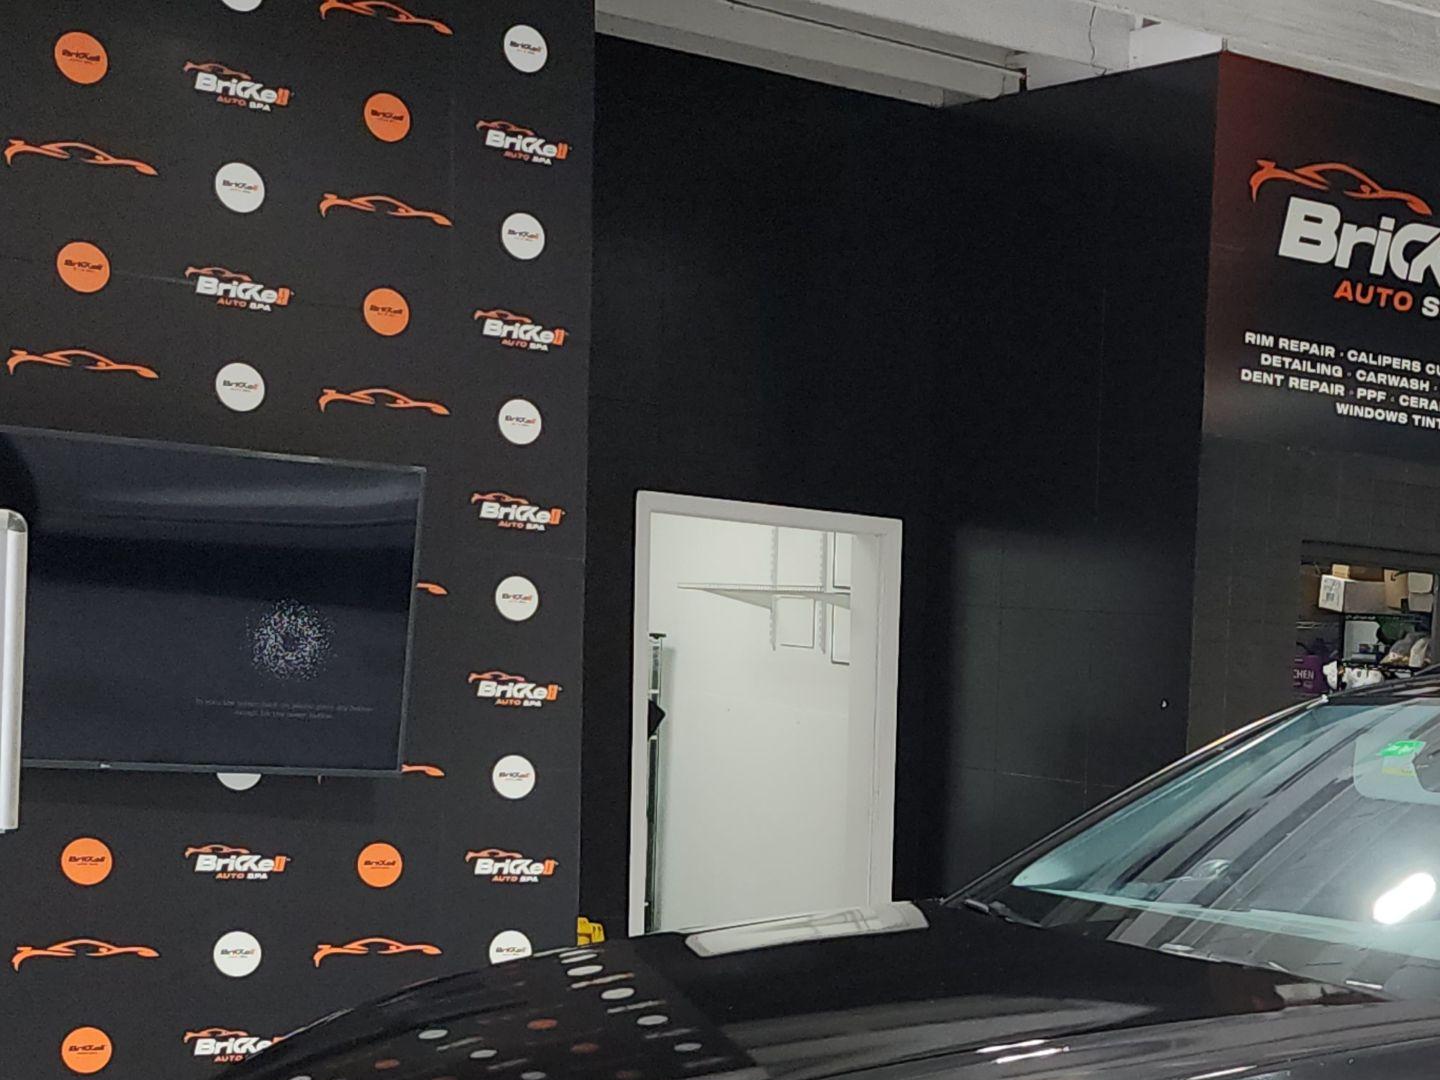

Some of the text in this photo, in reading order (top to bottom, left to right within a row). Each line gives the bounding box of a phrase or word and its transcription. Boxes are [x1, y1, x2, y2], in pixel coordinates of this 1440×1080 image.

[1333, 280, 1413, 312] AUTO
[1245, 331, 1274, 347] RIM
[1279, 337, 1335, 358] REPAIR
[1347, 350, 1421, 373] CALIPERS
[1241, 369, 1284, 387] DENT
[1289, 377, 1345, 396] REPAIR
[1356, 388, 1387, 402] PPF
[1261, 353, 1343, 378] DETAILING
[1355, 369, 1430, 392] CARWASH
[1336, 402, 1408, 424] WINDOWS
